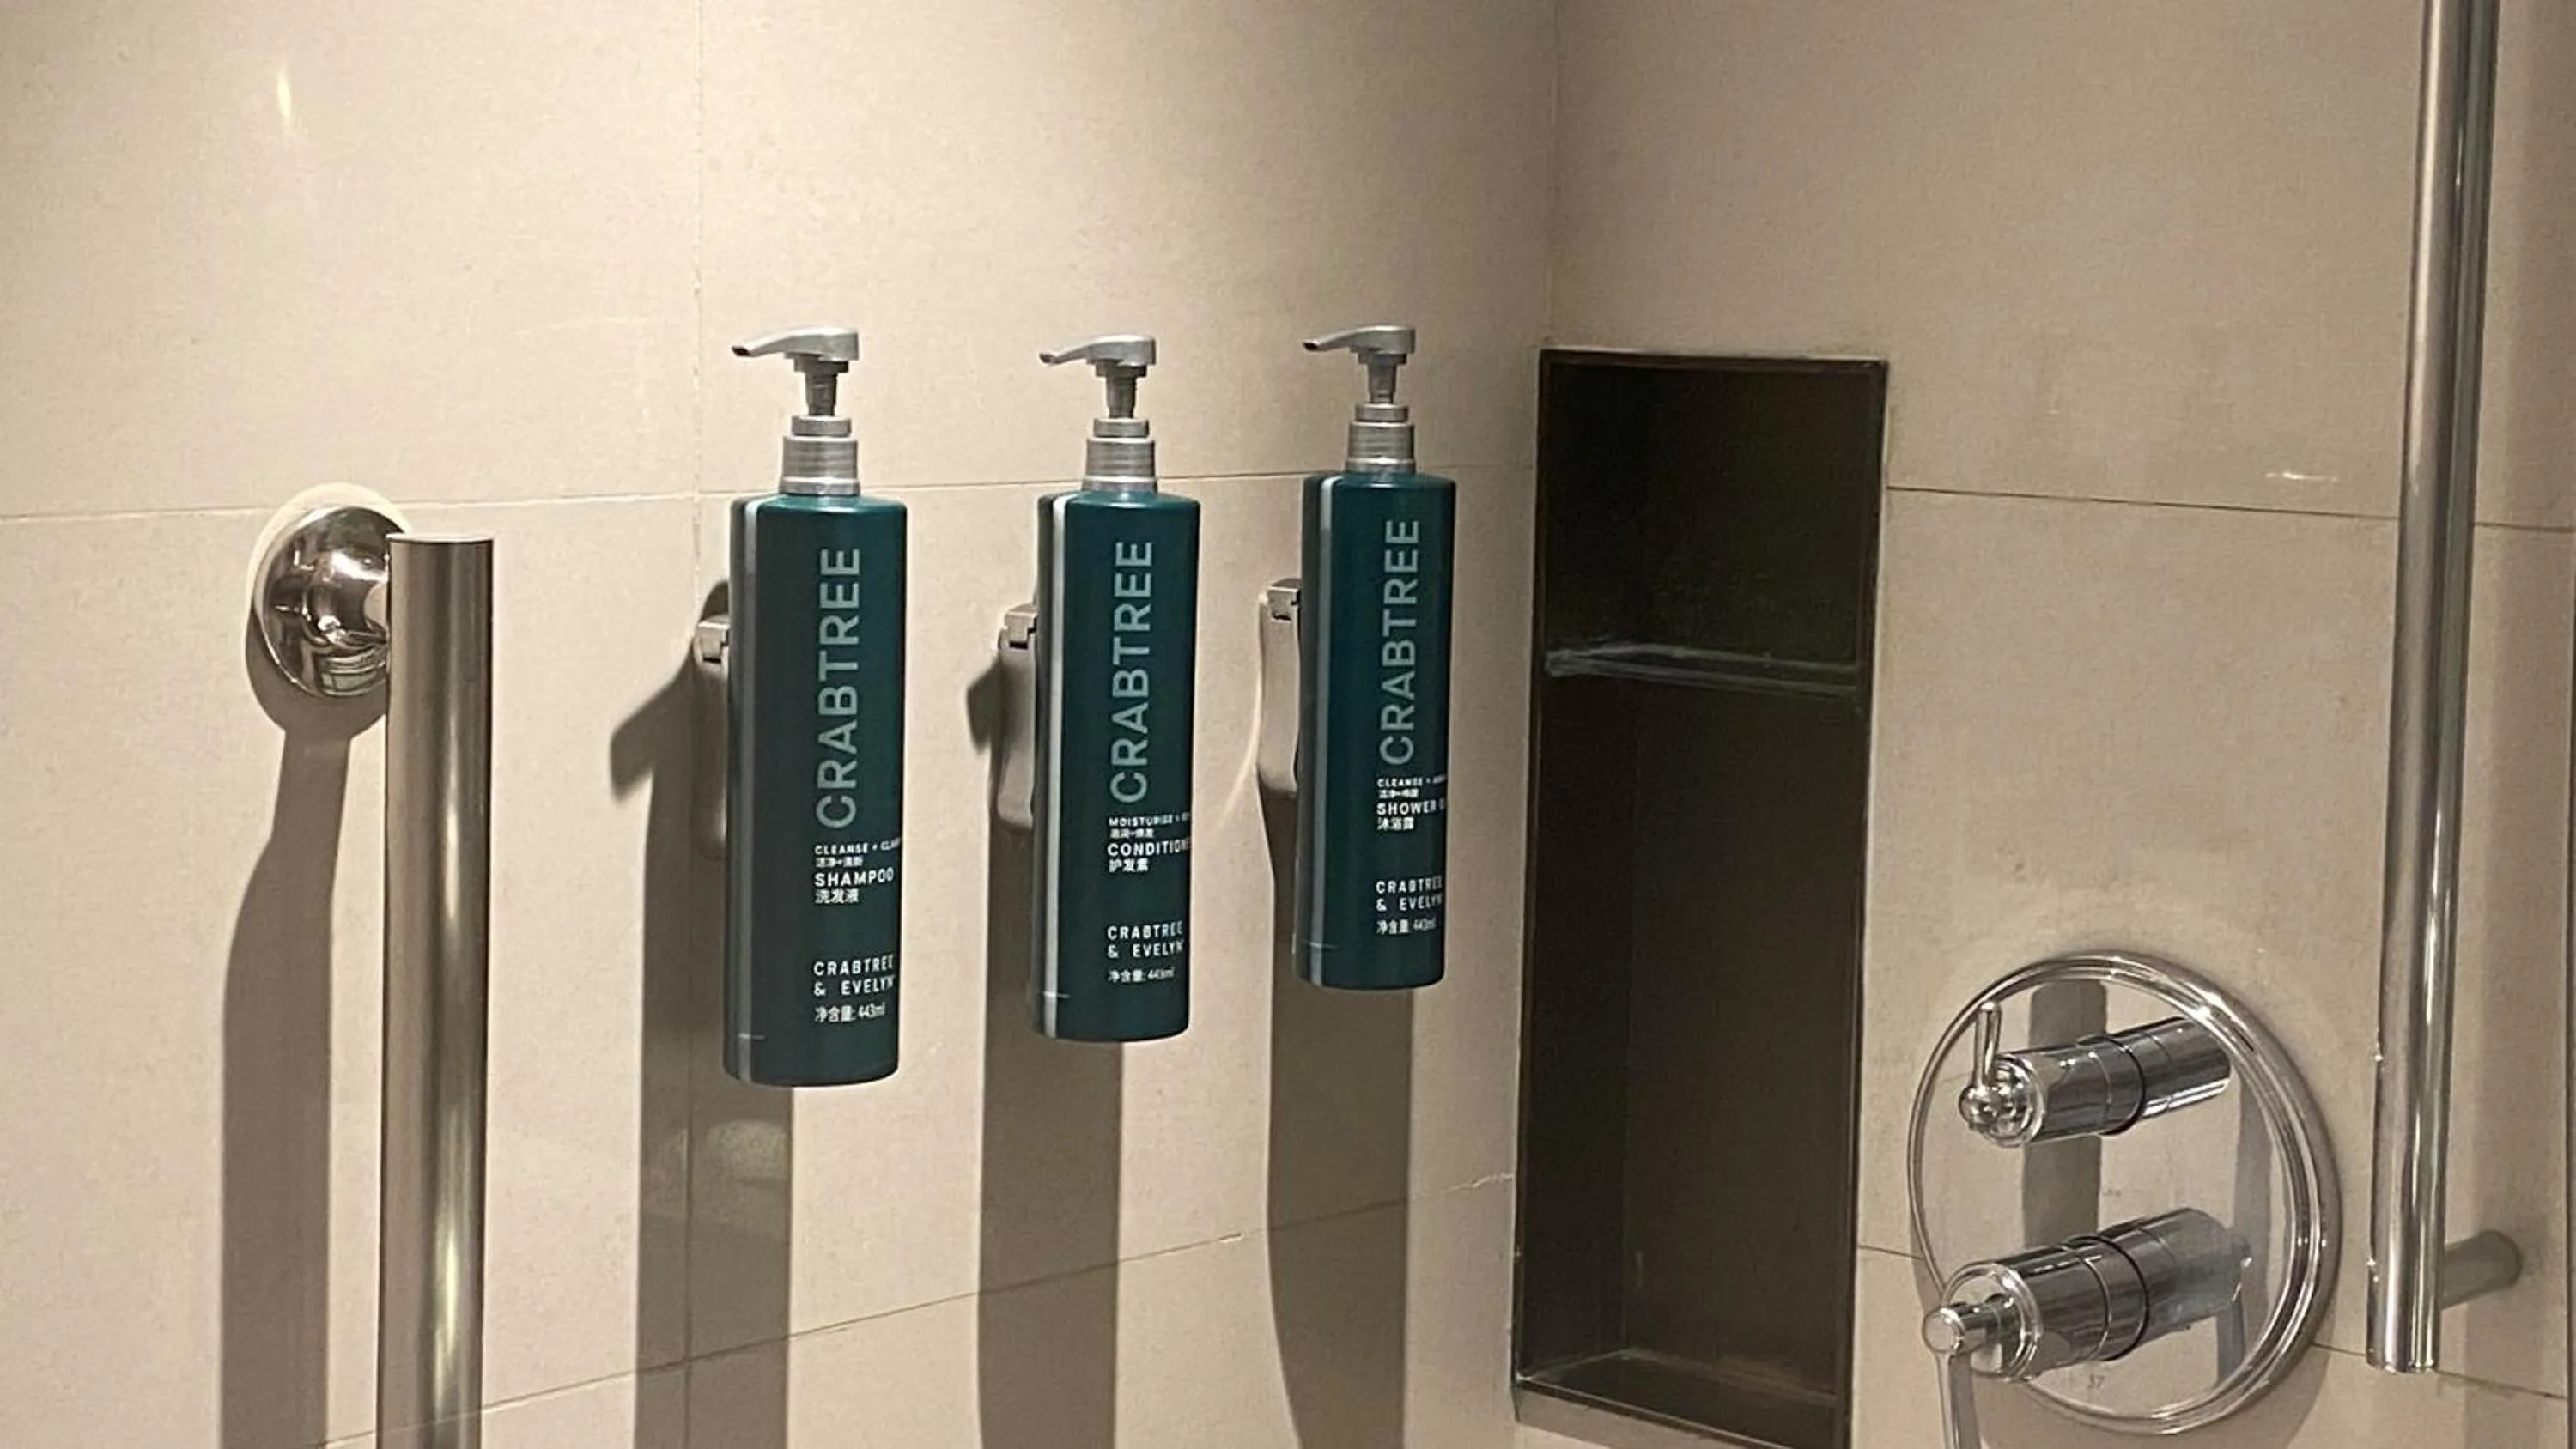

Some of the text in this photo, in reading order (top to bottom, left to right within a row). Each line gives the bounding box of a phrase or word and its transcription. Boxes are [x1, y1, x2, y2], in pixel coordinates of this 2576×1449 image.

[1379, 520, 1419, 765] CRABTREE
[1109, 542, 1152, 803] CRABTREE
[815, 549, 860, 828] CRABTREE
[1376, 776, 1423, 788] CLEANSE
[1376, 798, 1437, 816] SHOWER
[1376, 816, 1414, 831] 沐浴露
[814, 841, 869, 856] CLEANSE
[1109, 857, 1149, 873] 护发素
[814, 867, 895, 888] SHAMPOO
[1376, 875, 1443, 894] CRABTREE
[815, 888, 860, 904] 洗发液
[1376, 892, 1443, 912] & EVELYN
[1107, 919, 1183, 940] CRABTREE
[1107, 939, 1184, 959] & EVELYN
[813, 954, 894, 977] CRABTREE
[813, 974, 896, 997] & EVELYN
